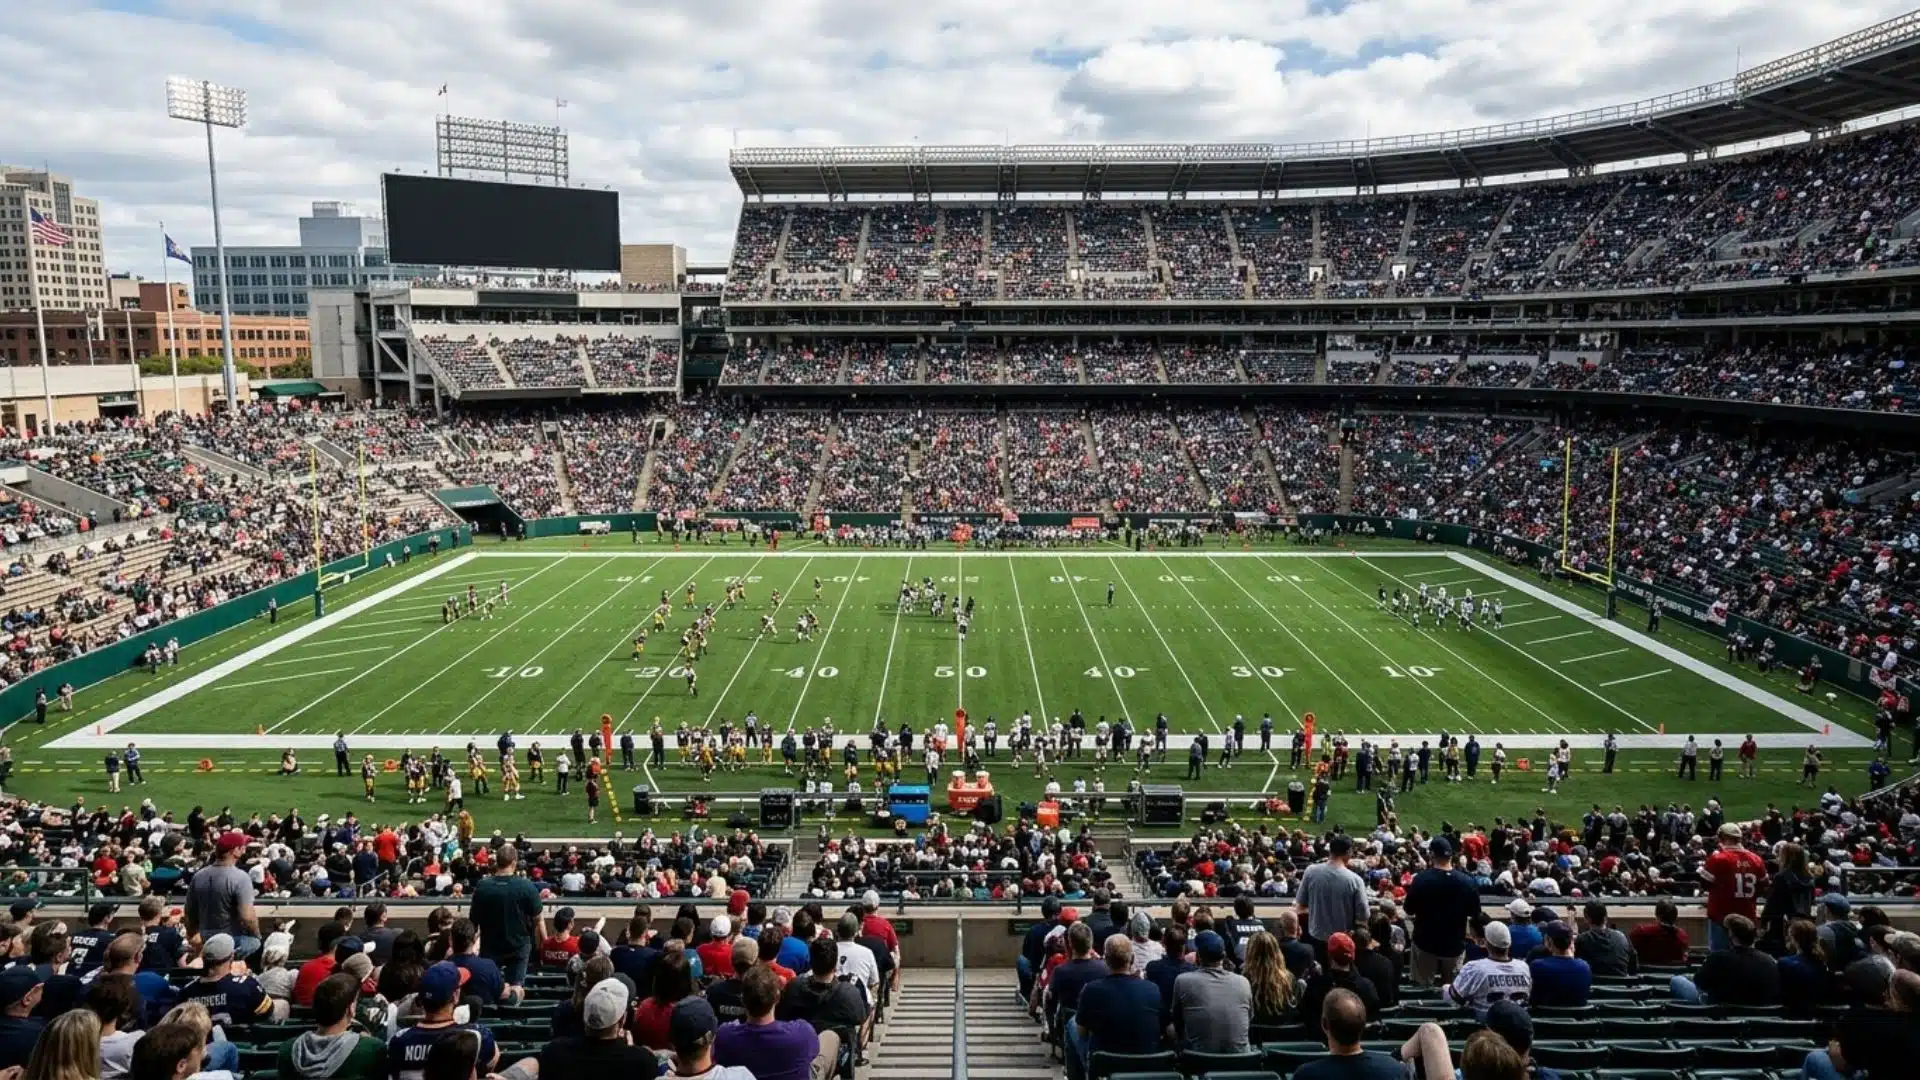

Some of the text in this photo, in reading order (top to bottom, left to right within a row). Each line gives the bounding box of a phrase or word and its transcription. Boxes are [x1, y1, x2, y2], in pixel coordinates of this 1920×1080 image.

[487, 666, 544, 678] 10
[785, 666, 839, 678] 40
[934, 666, 987, 678] 50
[1082, 666, 1136, 678] 40
[1230, 666, 1286, 678] 30
[1381, 666, 1434, 678] 10
[1734, 872, 1757, 898] 13
